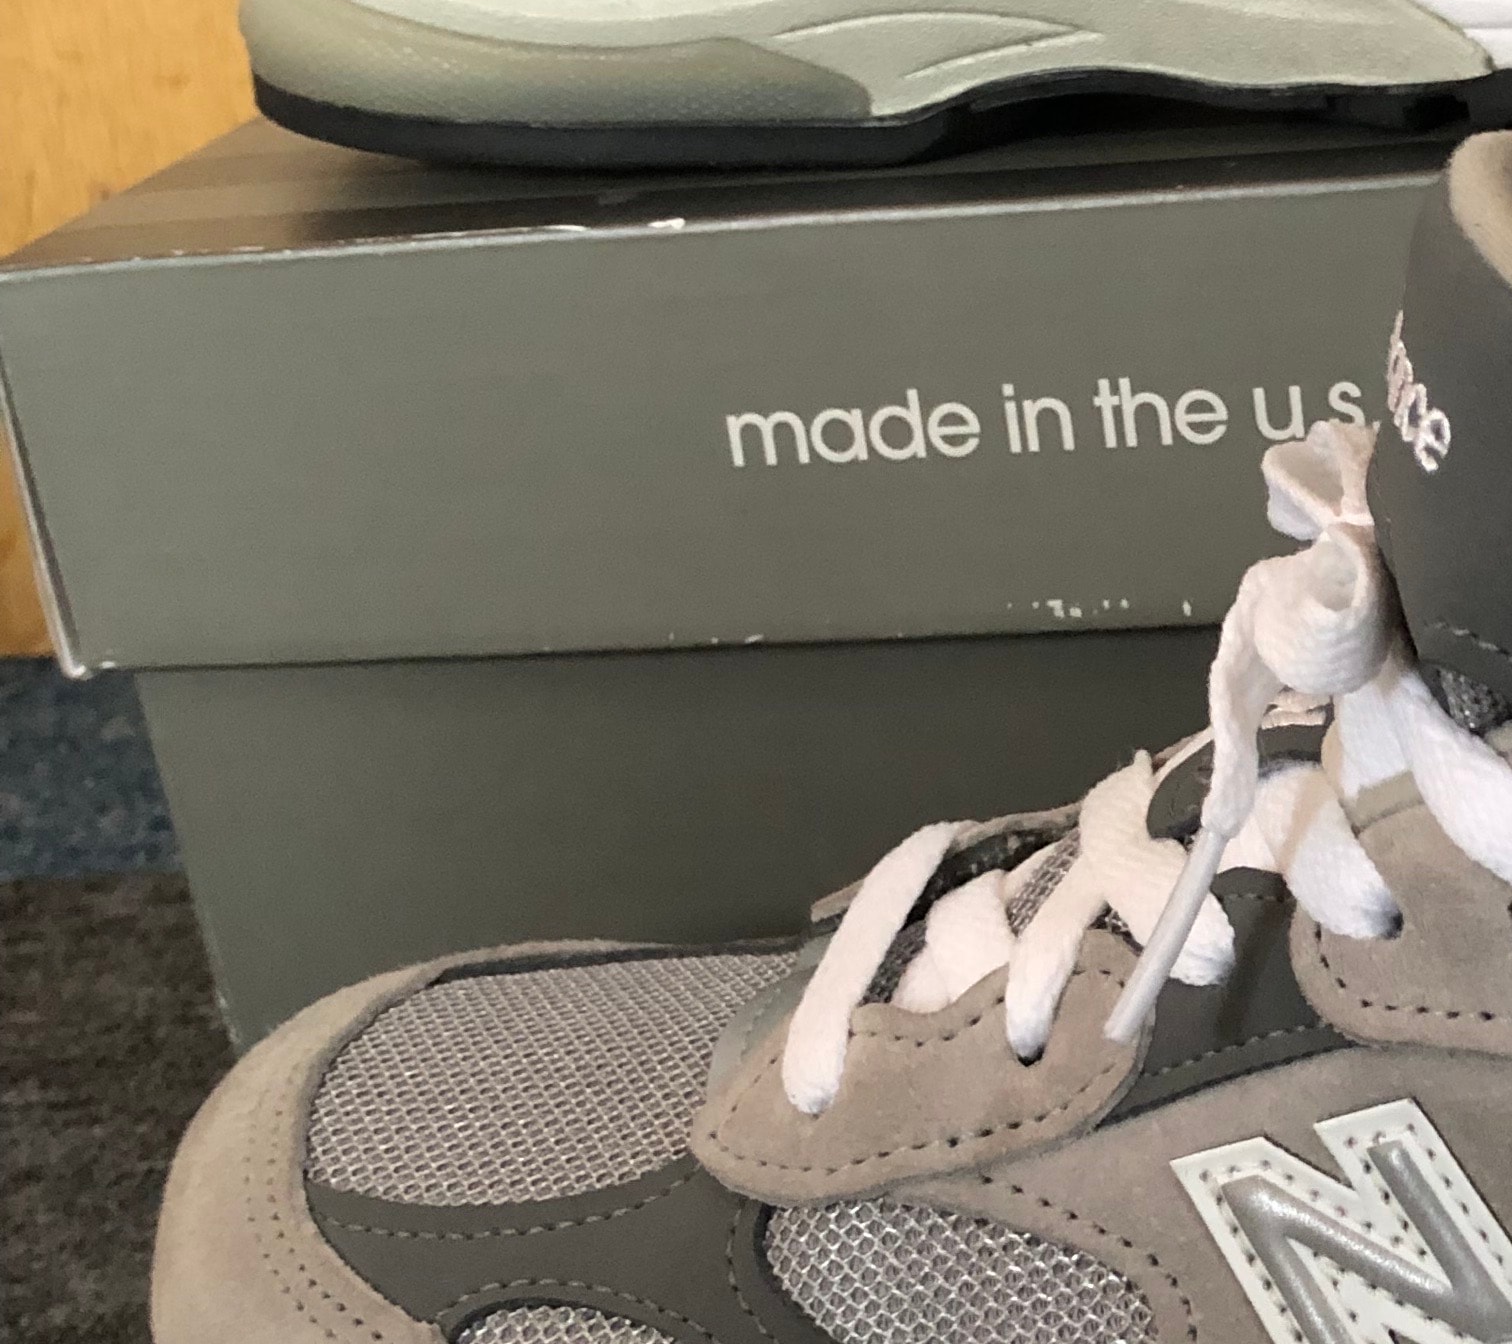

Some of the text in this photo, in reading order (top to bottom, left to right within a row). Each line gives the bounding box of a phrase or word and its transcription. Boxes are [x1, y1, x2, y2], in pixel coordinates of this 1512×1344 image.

[725, 388, 981, 467] made
[1002, 383, 1075, 453] in
[1093, 377, 1229, 449] the
